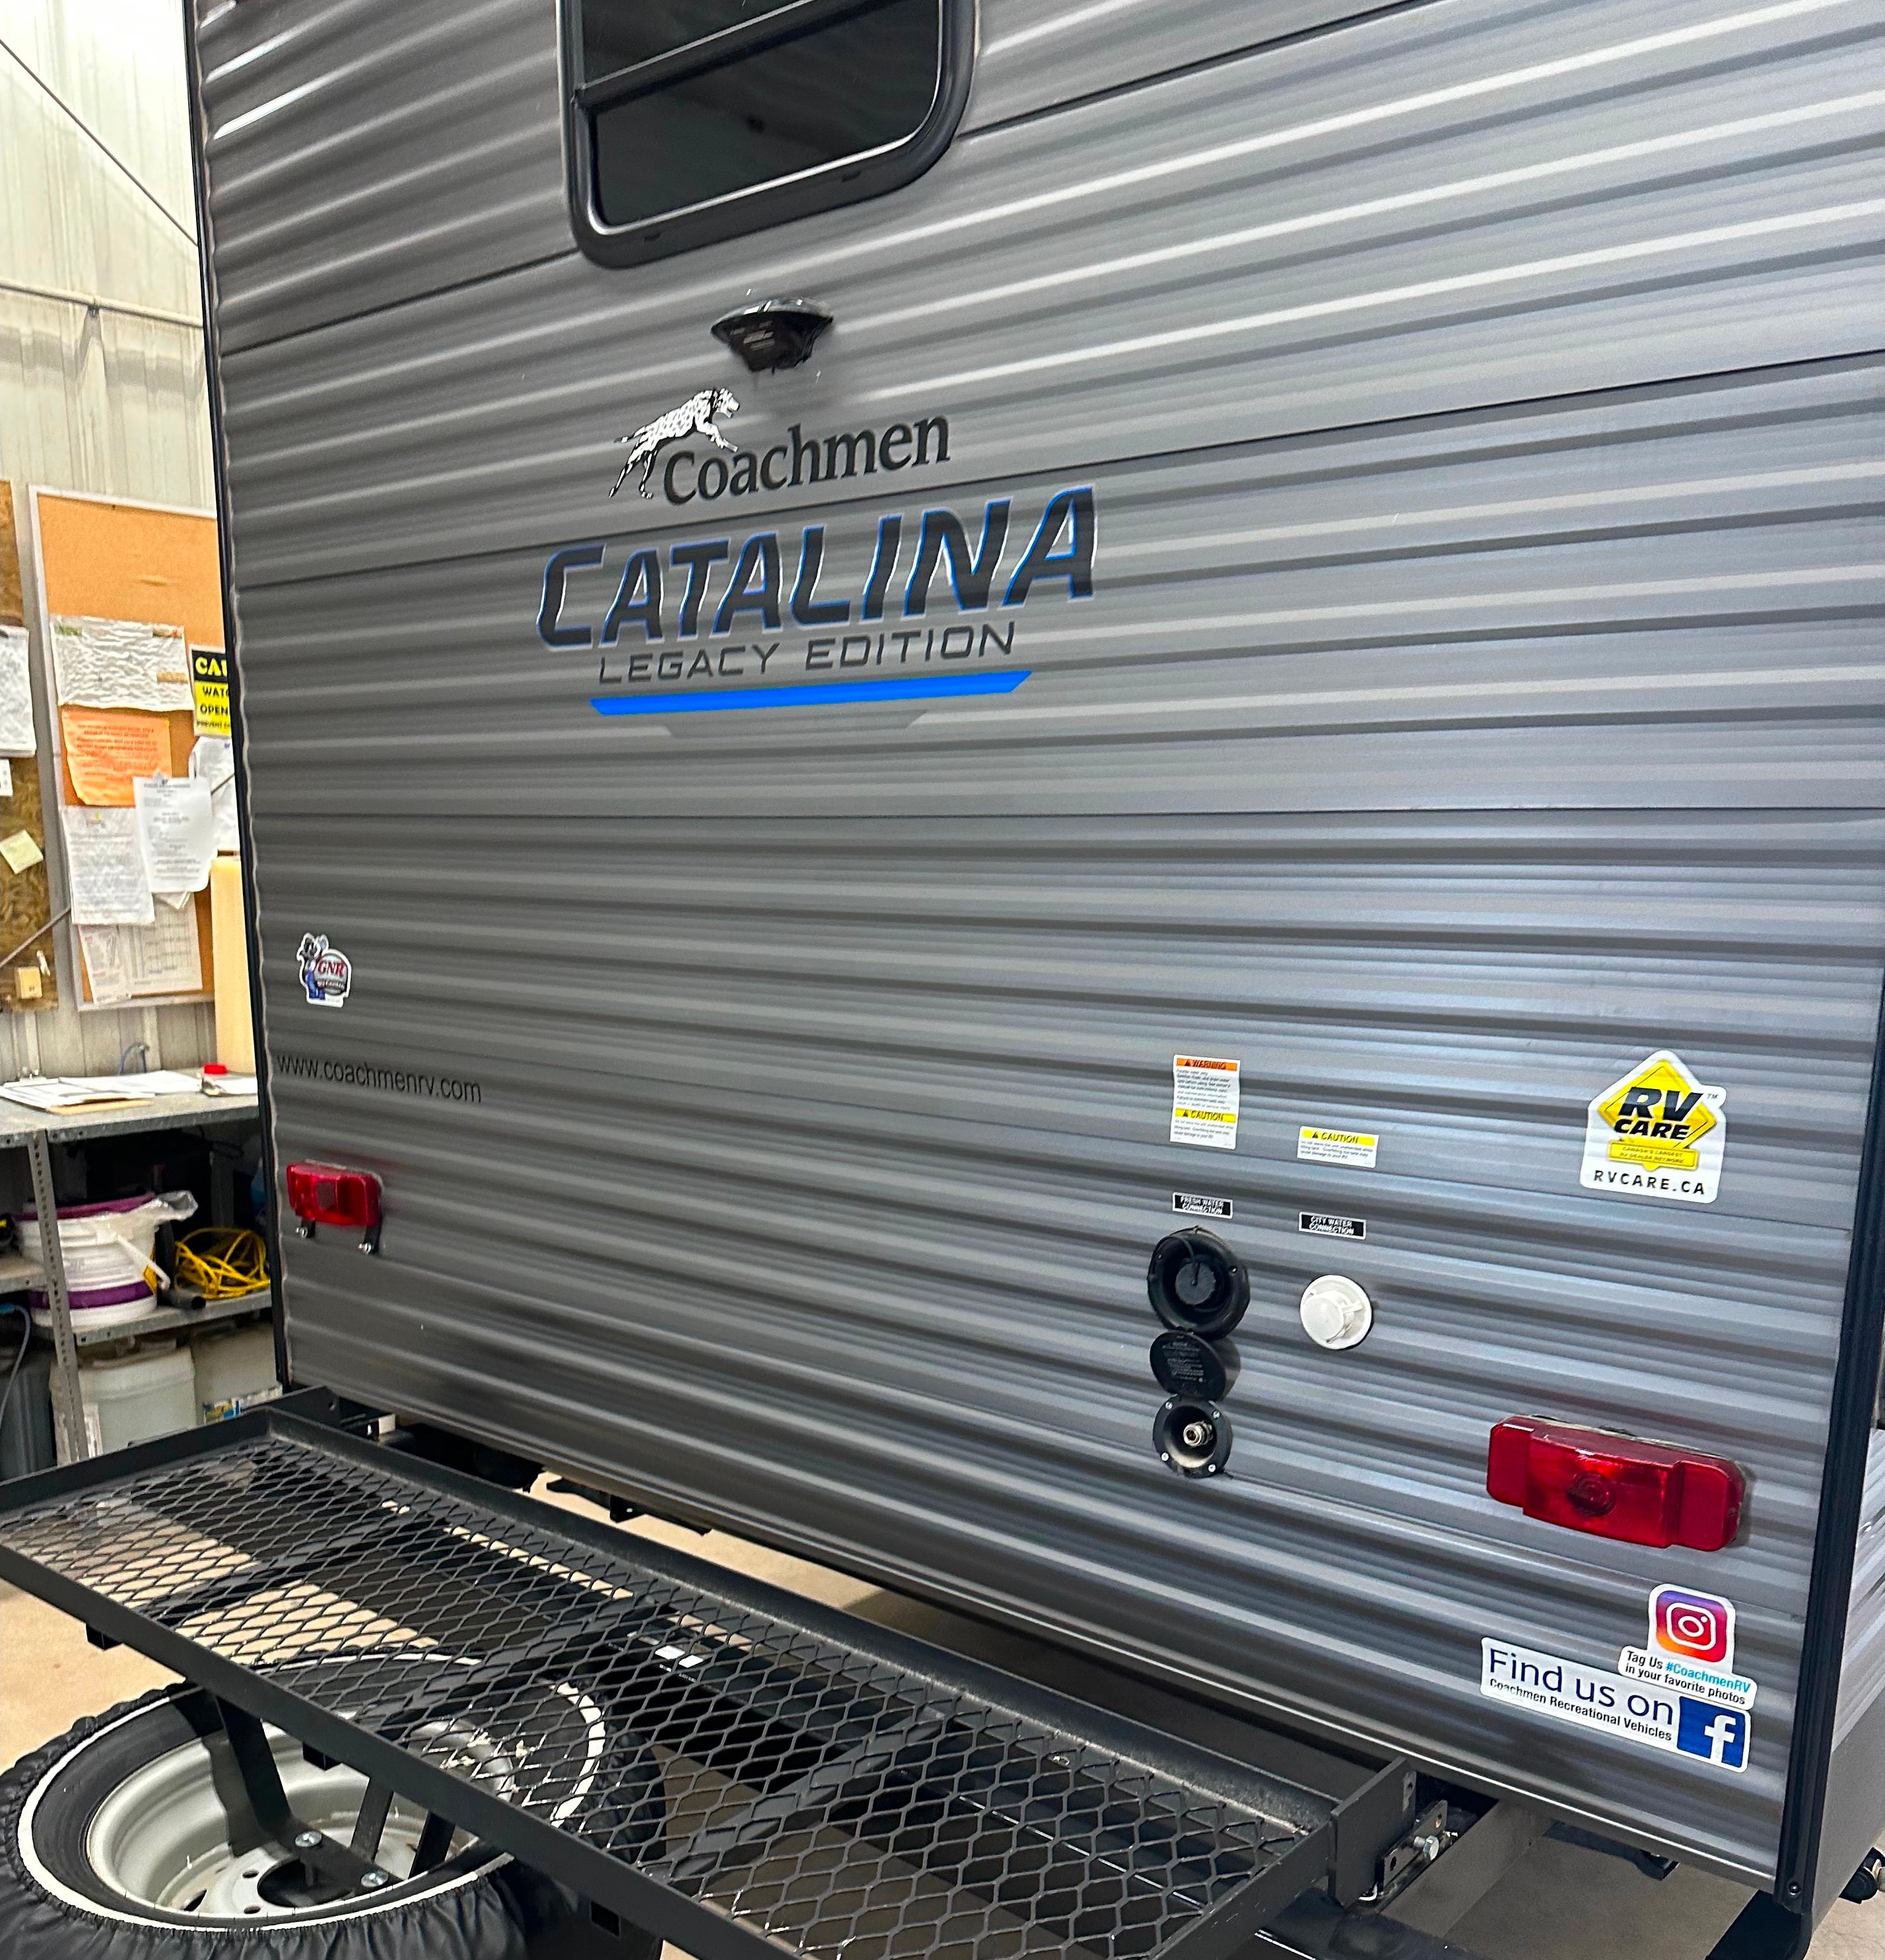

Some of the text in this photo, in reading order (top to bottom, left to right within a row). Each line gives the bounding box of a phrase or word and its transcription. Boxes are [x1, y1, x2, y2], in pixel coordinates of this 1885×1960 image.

[664, 415, 951, 505] Coachmen
[537, 484, 1097, 650] CATALINA
[599, 621, 1015, 685] LEGACY EDITION
[318, 961, 344, 977] GNR
[277, 1055, 481, 1103] www.coachmenrv.com
[1192, 1059, 1227, 1070] WARNING
[1191, 1110, 1224, 1121] CAUTION
[1618, 1086, 1704, 1121] RV
[1321, 1132, 1360, 1144] CAUTION
[1614, 1119, 1692, 1140] CARE
[1594, 1170, 1705, 1195] RVCARE.CA
[1309, 1222, 1354, 1236] CONNECTION
[1311, 1215, 1353, 1228] CITY WATER
[1490, 1648, 1674, 1726] Find us on
[1625, 1663, 1746, 1705] in your favorite photos
[1627, 1650, 1751, 1694] Tag Us #CoachmenRV
[1490, 1678, 1672, 1741] Coachmen Recreational Vehicles
